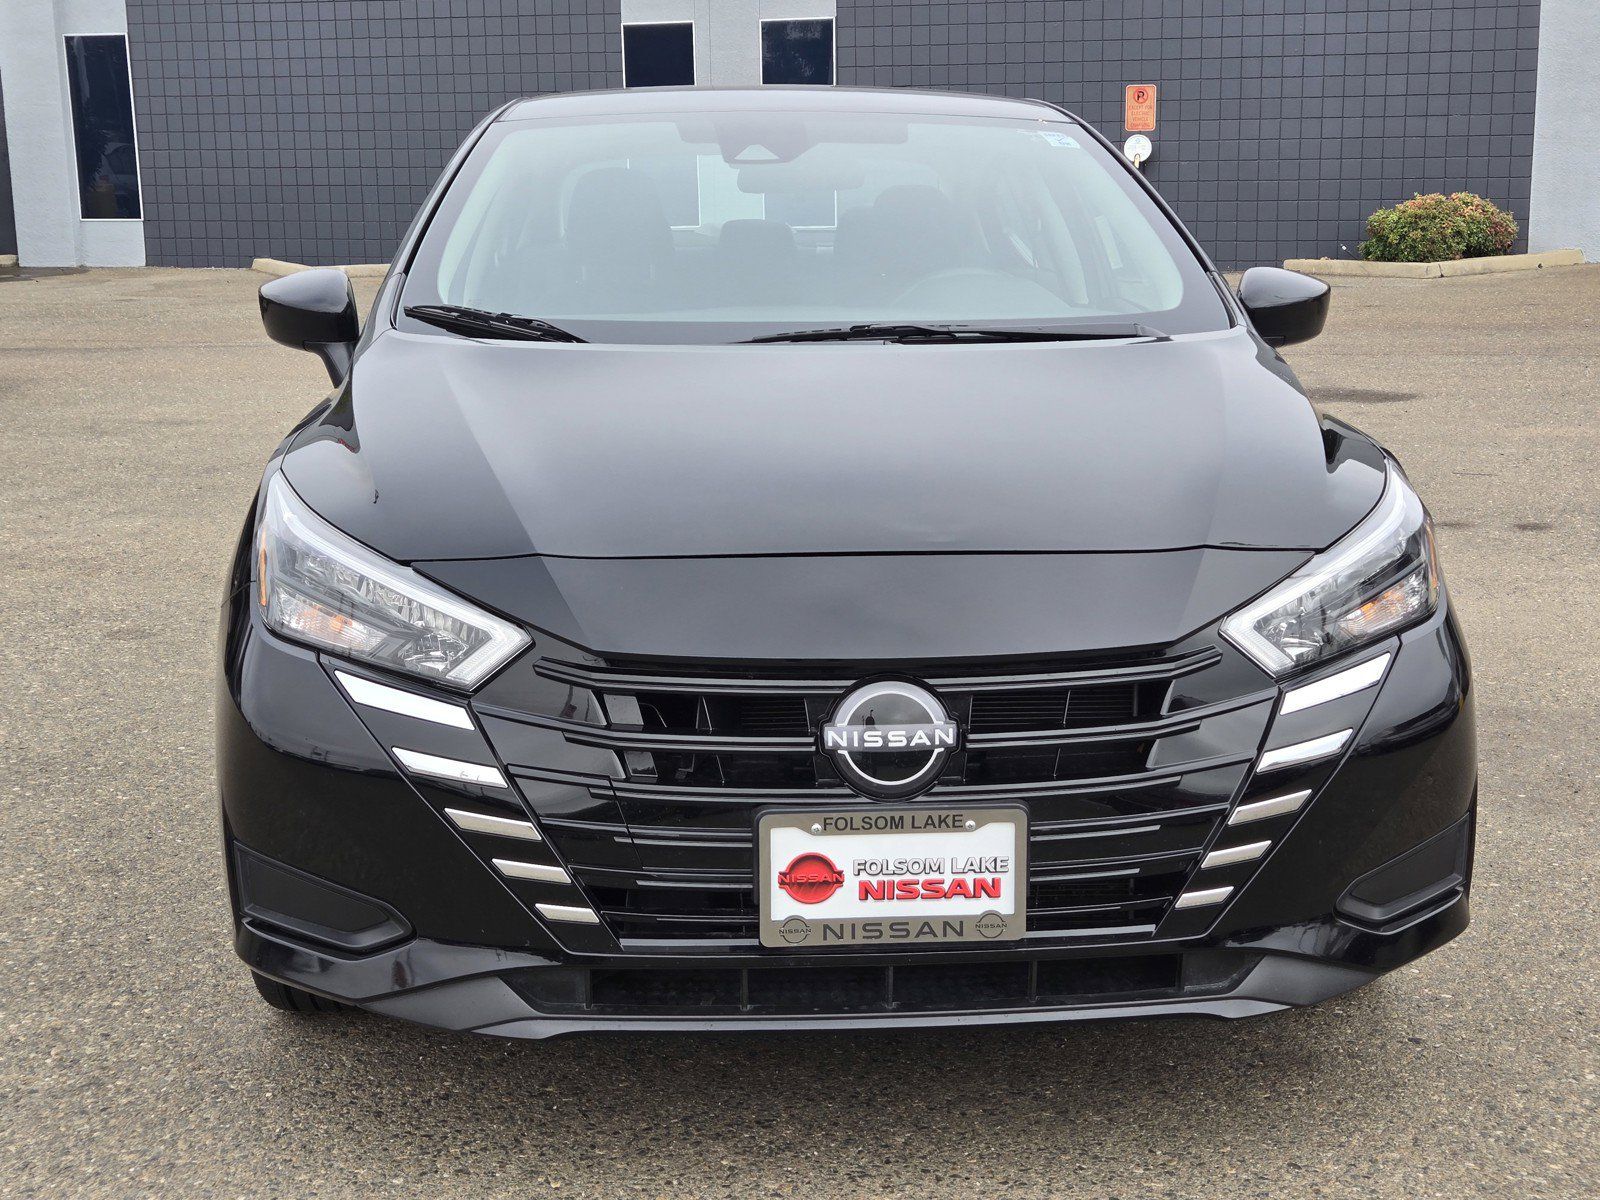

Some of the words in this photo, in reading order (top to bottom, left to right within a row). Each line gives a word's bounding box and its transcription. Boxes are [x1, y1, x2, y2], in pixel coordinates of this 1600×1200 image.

[827, 728, 954, 748] NISSAN
[823, 815, 905, 831] FOLSOM
[911, 814, 964, 830] LAKE
[853, 857, 945, 876] FOLSOM
[951, 856, 1010, 875] LAKE
[778, 873, 845, 885] NISSAN
[858, 877, 1002, 901] NISSAN
[822, 920, 964, 942] NISSAN
